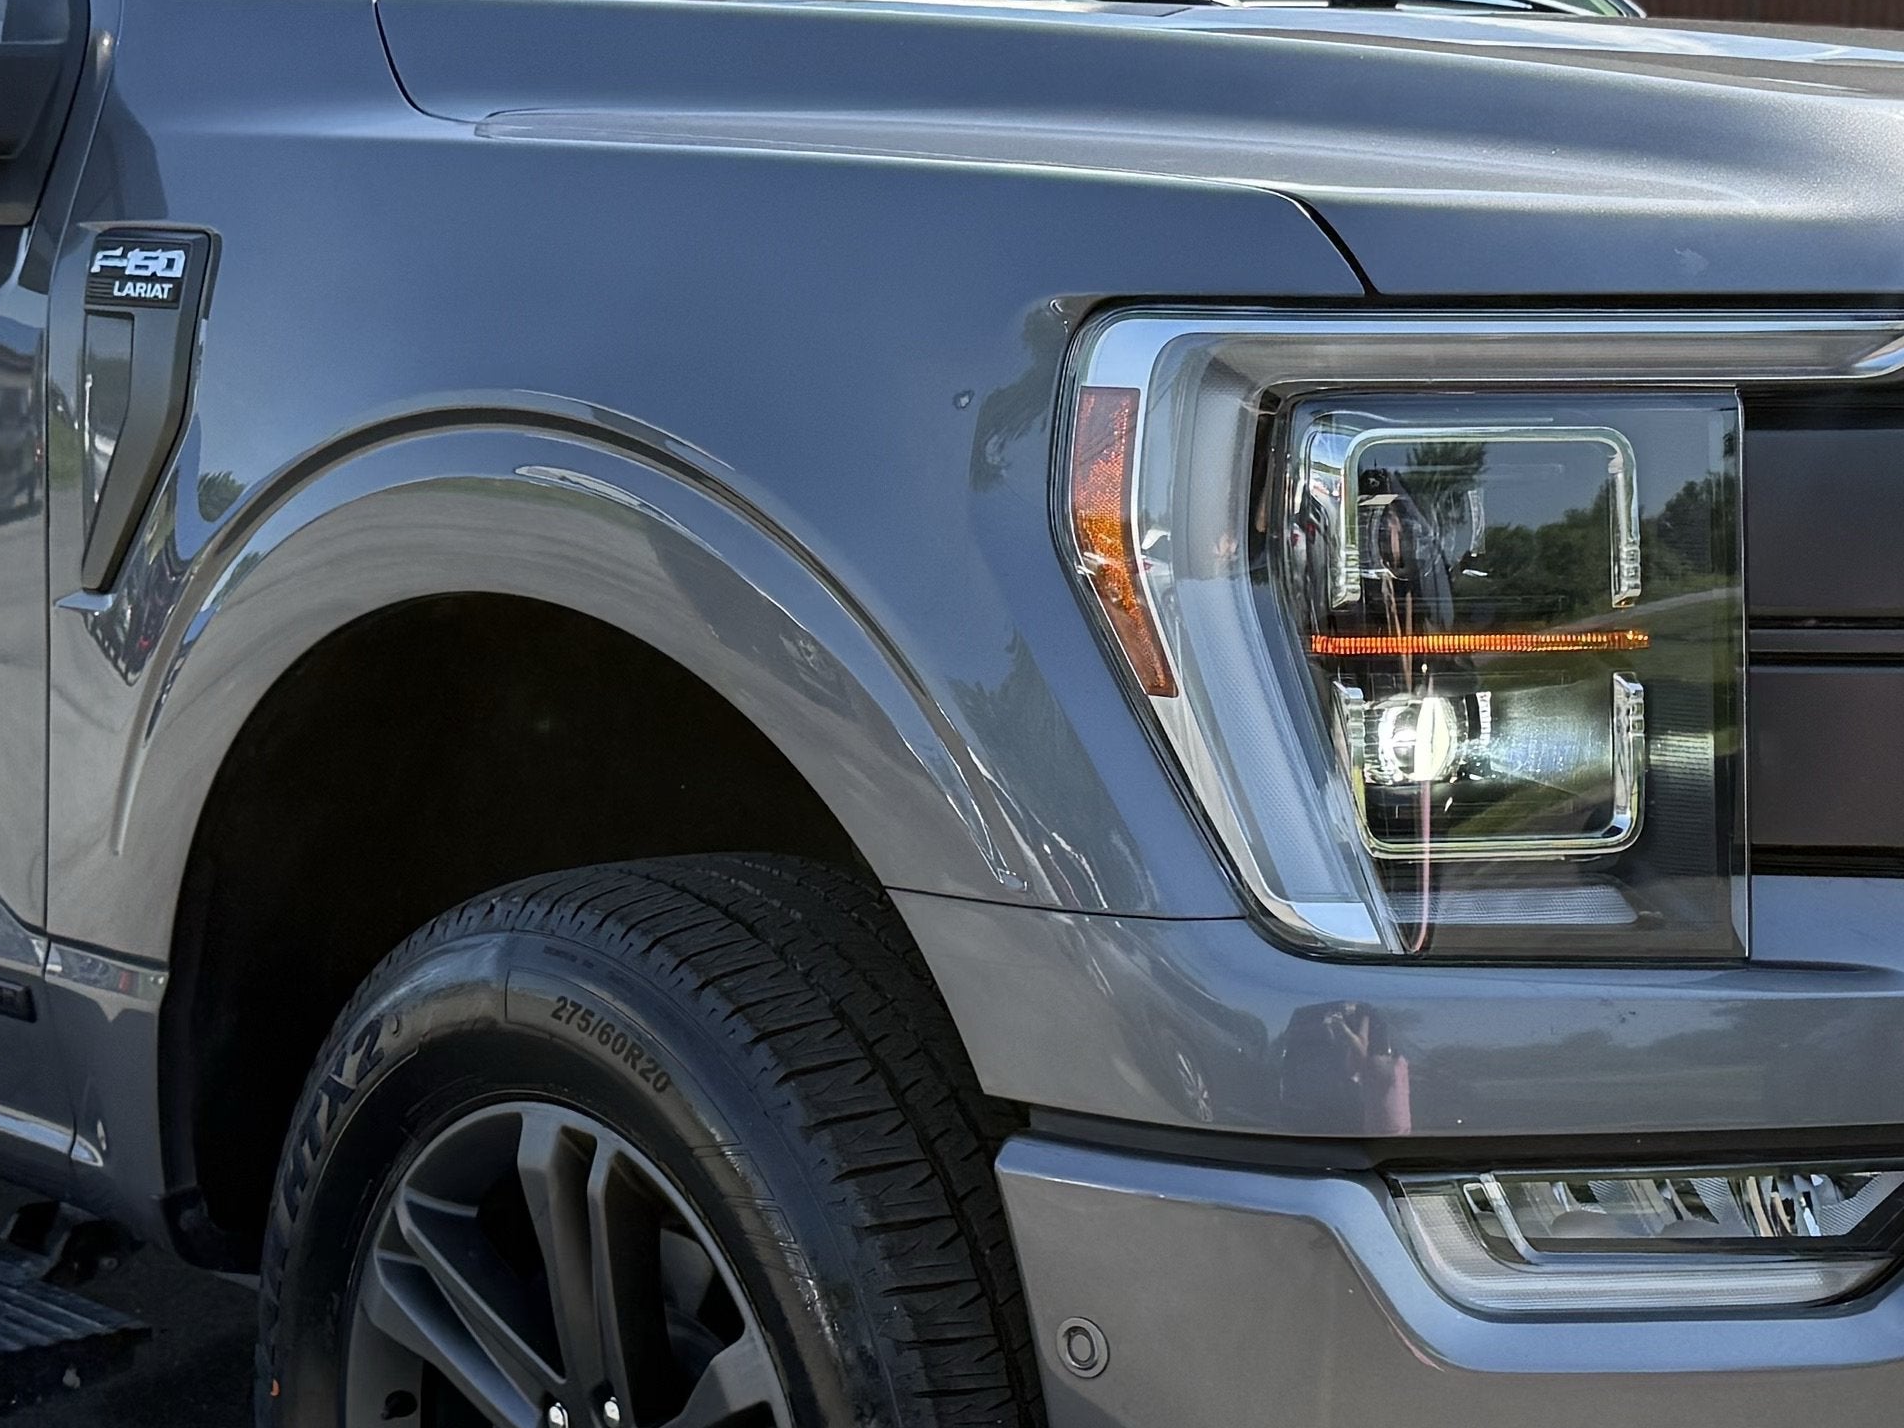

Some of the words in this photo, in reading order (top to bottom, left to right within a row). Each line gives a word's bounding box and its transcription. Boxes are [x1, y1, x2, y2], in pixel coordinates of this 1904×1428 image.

[91, 246, 186, 278] F-150
[113, 280, 173, 299] LARIAT
[549, 994, 672, 1094] 275/60R20
